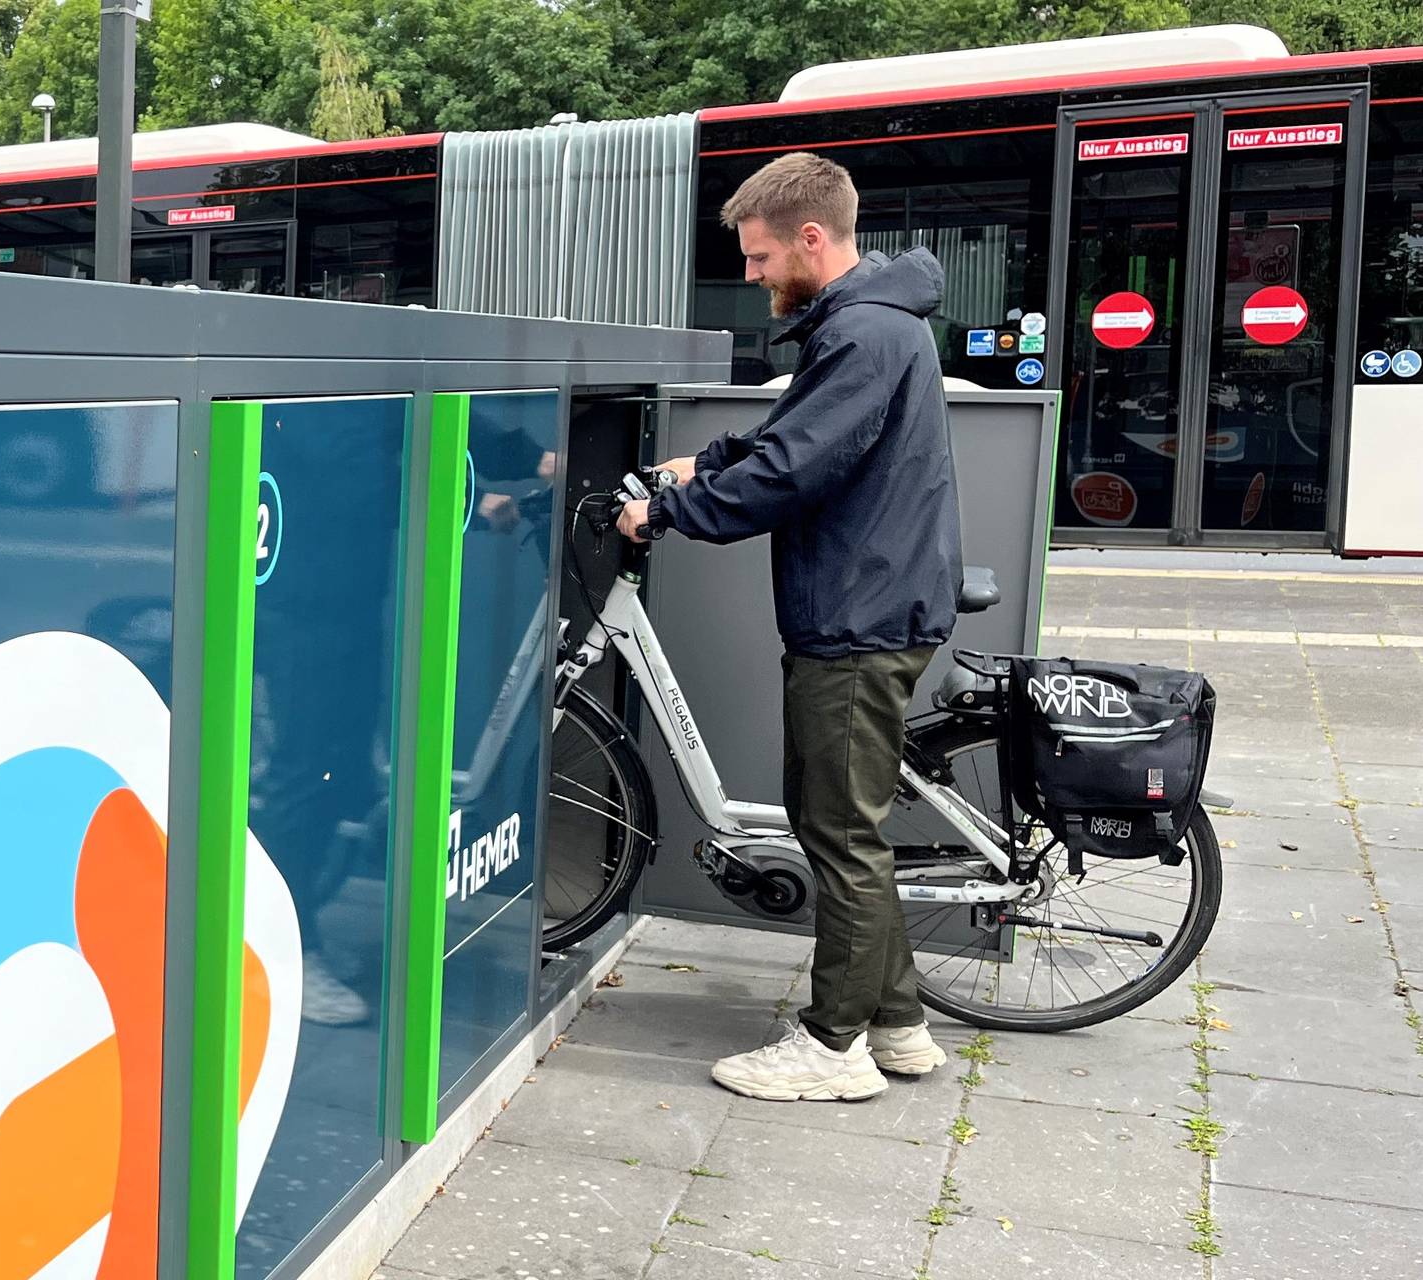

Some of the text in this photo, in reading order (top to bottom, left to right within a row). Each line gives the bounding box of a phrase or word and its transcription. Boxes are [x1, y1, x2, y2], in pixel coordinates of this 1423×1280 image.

[1233, 127, 1337, 146] Nur Ausstieg
[1084, 137, 1182, 156] Nur Ausstieg
[171, 209, 232, 221] Nur Ausstieg
[256, 503, 270, 560] 2
[1034, 692, 1133, 718] WIND
[668, 687, 700, 751] PEGASUS
[1091, 816, 1132, 830] NORTH
[1091, 825, 1132, 839] WIND
[461, 812, 521, 902] HEMER
